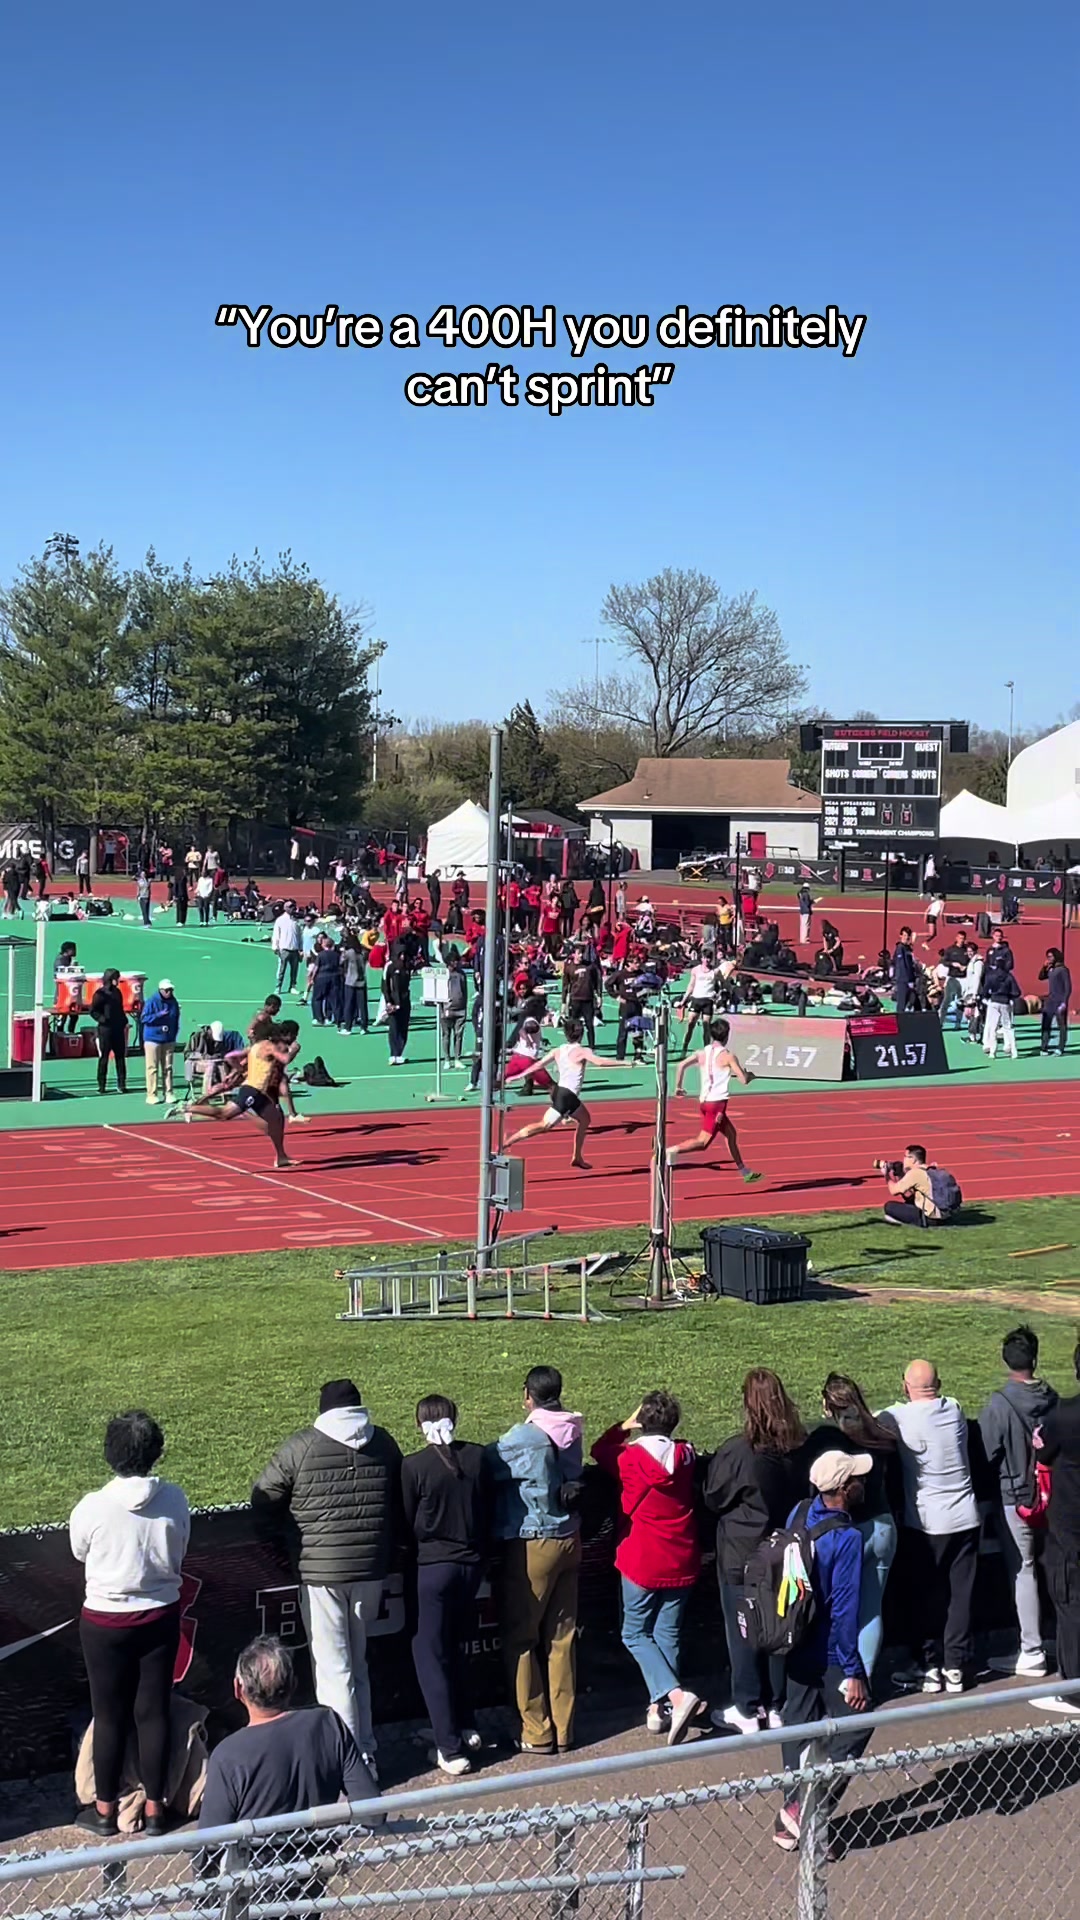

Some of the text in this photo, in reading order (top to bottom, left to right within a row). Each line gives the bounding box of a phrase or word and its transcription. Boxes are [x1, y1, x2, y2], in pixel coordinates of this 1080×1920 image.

[834, 729, 930, 737] RUTGERS FIELD HOCKEY
[914, 743, 938, 752] GUEST
[825, 769, 850, 779] SHOTS
[911, 770, 937, 779] SHOTS
[897, 829, 935, 837] CHAMPIONS
[745, 1044, 819, 1068] 21.57
[874, 1043, 928, 1068] 21.57
